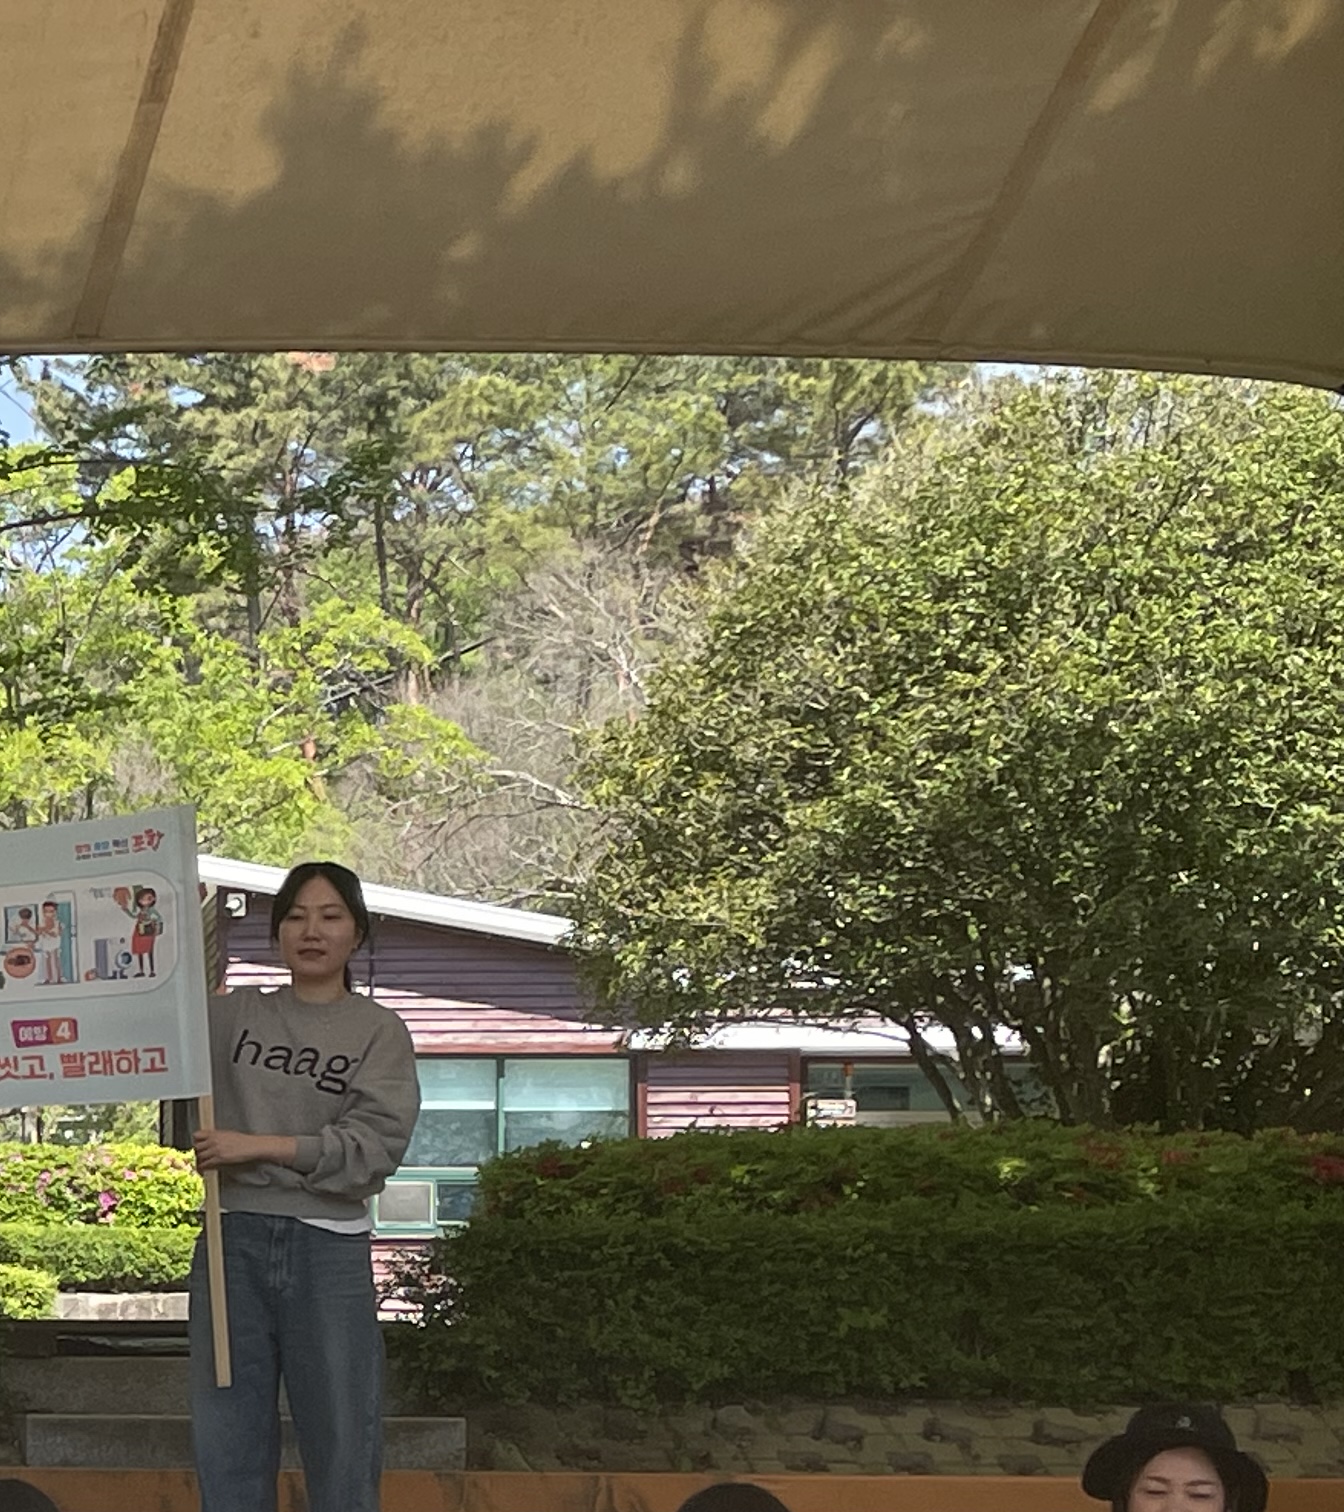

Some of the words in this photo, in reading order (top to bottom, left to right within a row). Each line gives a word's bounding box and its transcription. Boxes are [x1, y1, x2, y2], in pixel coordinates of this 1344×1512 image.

[57, 1022, 71, 1039] 4
[60, 1047, 170, 1079] 빨래하고
[232, 1029, 359, 1095] haag
